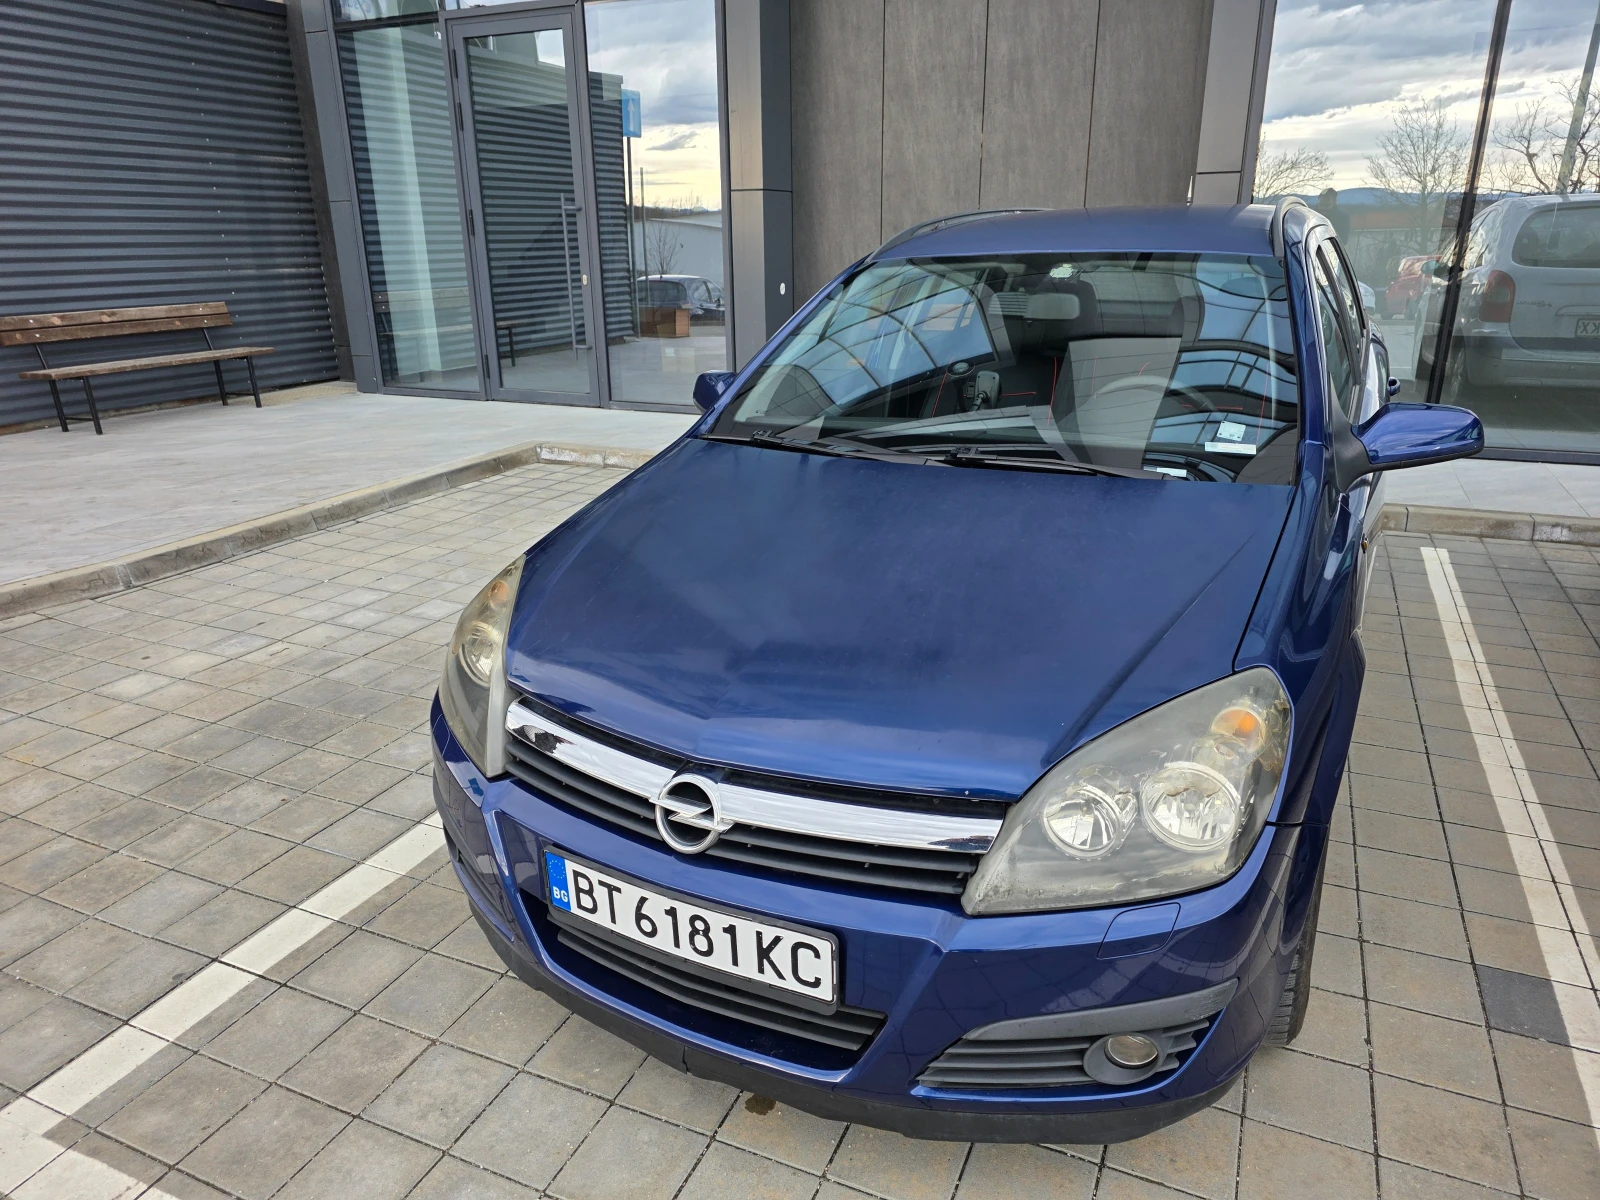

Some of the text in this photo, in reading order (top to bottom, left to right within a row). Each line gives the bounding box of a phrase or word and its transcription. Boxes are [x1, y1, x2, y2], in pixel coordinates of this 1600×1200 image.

[552, 885, 569, 903] BG
[572, 868, 822, 989] BT 6181 KC
